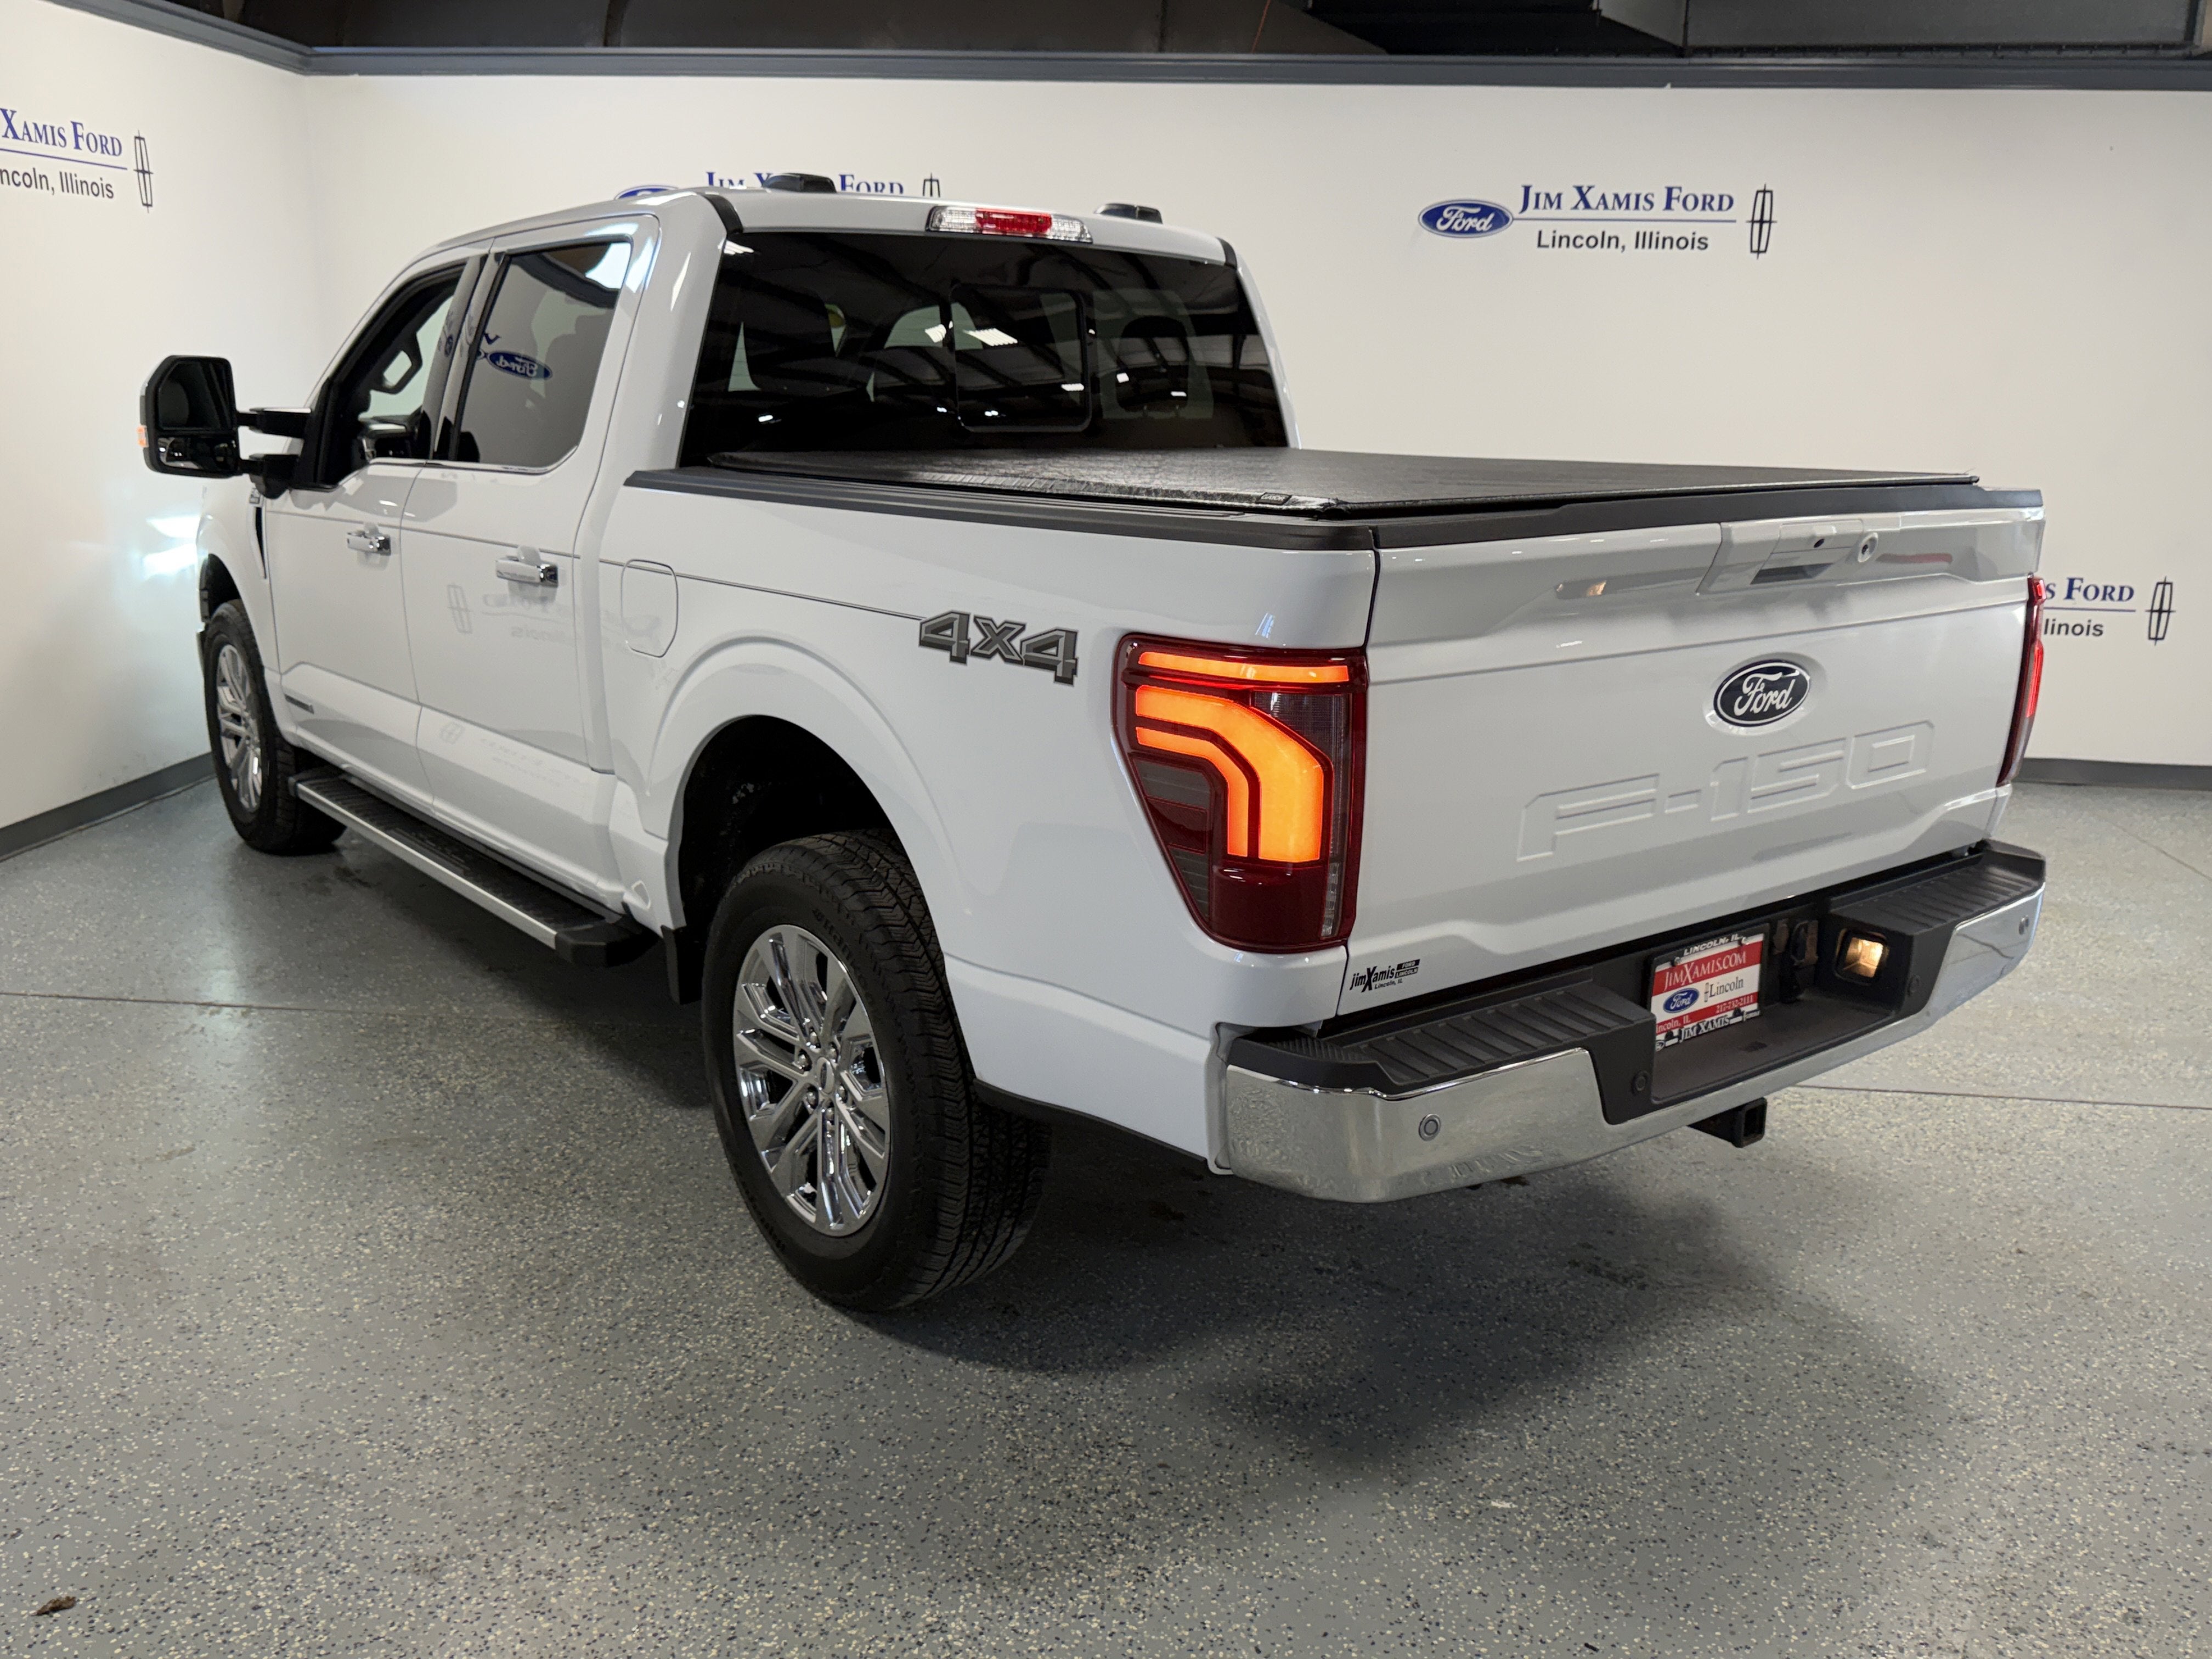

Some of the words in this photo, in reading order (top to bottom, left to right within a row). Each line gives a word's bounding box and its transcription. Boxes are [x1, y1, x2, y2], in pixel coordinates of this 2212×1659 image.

[0, 108, 67, 148] XAMIS
[71, 121, 122, 157] FORD
[0, 167, 54, 195] ncoln,
[59, 171, 114, 199] Illinois
[1519, 184, 1564, 214] JIM
[1570, 185, 1655, 211] XAMIS
[1662, 186, 1734, 212] FORD
[1436, 205, 1494, 231] Ford
[1537, 230, 1626, 253] Lincoln,
[1634, 230, 1709, 251] Illinois
[2063, 577, 2135, 602] FORD
[2043, 618, 2104, 637] linois
[1734, 672, 1796, 716] Ford
[1517, 720, 1935, 862] F-150
[1664, 951, 1747, 991] JIMXAMIS.COM
[1670, 992, 1692, 1009] Ford
[1709, 977, 1744, 997] Lincoln
[1679, 1026, 1697, 1043] JIM
[1699, 1017, 1729, 1035] XAMIS
